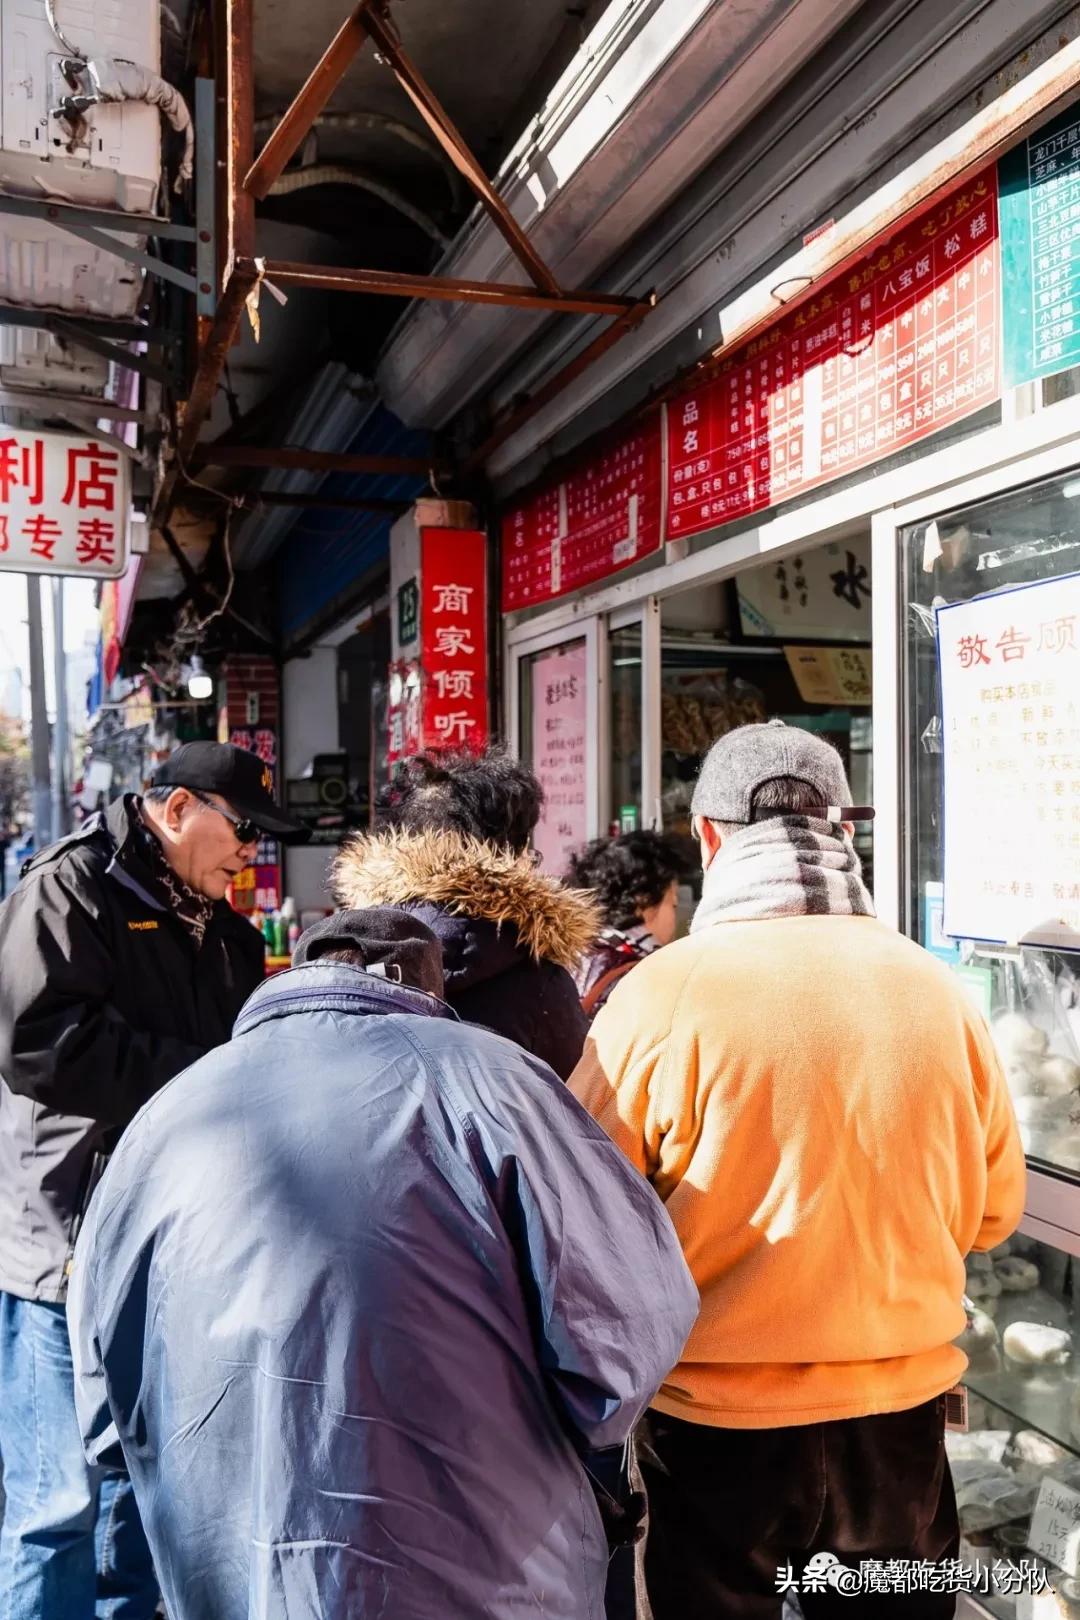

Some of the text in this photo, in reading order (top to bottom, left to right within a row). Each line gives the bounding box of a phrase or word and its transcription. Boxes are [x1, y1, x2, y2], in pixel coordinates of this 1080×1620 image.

[882, 254, 930, 302] 八宝饭
[683, 400, 699, 454] 品名
[0, 438, 119, 512] 利店
[432, 583, 476, 741] 商家倾听
[957, 615, 1077, 669] 敬告顾
